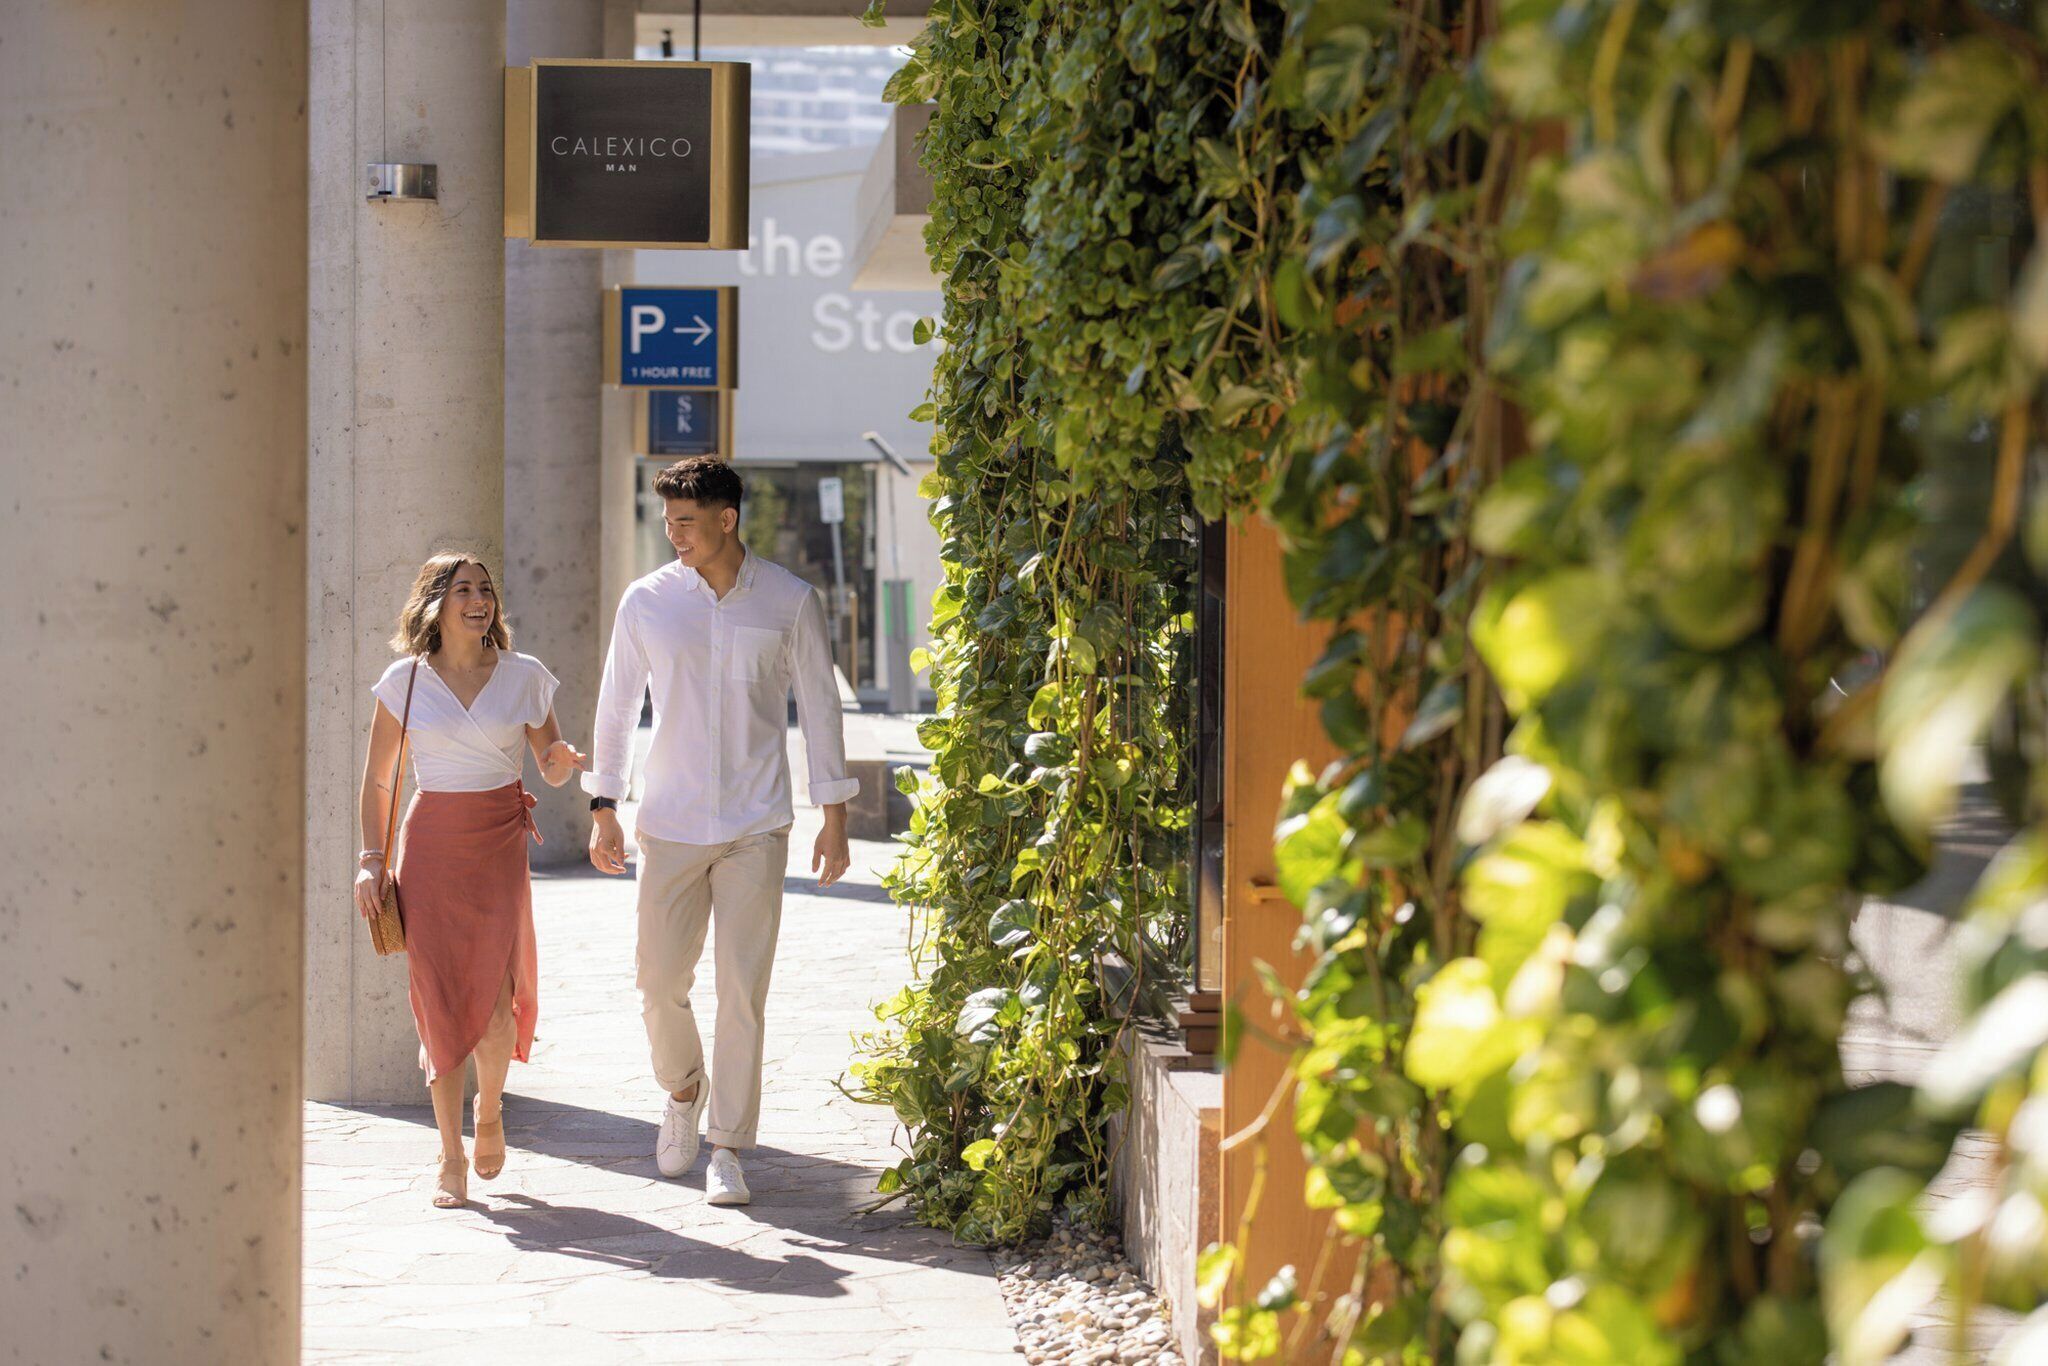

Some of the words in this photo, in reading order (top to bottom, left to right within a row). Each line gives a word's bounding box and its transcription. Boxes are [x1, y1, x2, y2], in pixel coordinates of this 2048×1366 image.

[551, 136, 691, 157] CALEXICO
[606, 164, 637, 172] MAN
[630, 305, 666, 354] P
[631, 366, 638, 378] 1
[641, 366, 679, 379] HOUR
[682, 366, 712, 379] FREE
